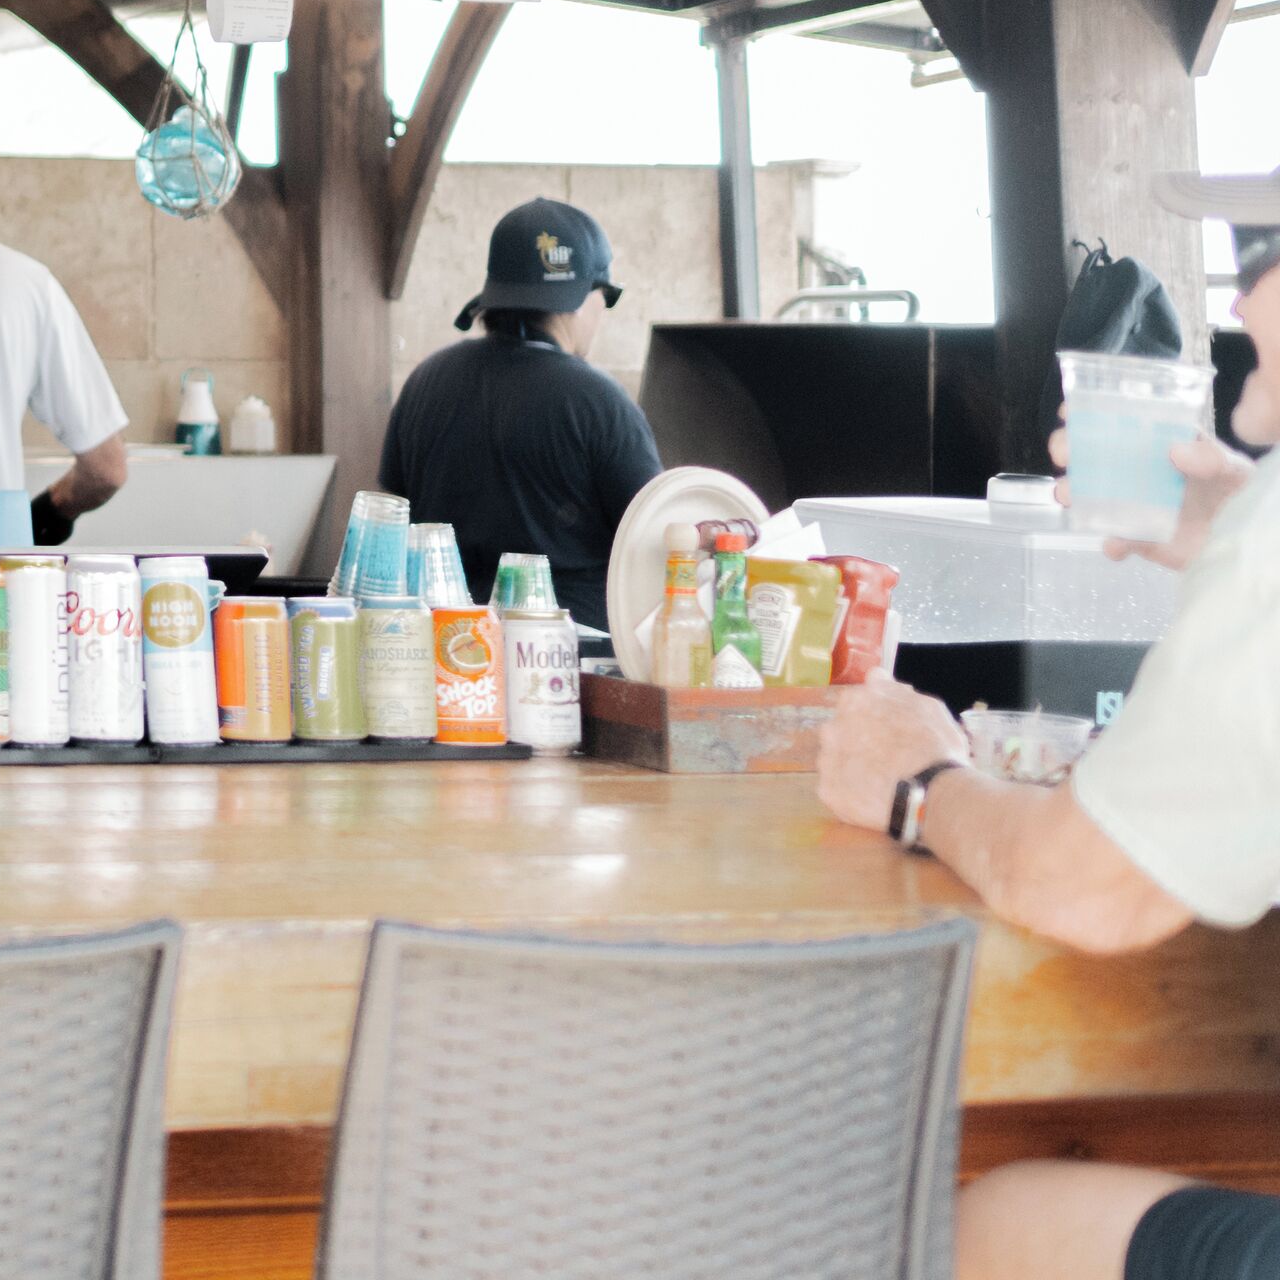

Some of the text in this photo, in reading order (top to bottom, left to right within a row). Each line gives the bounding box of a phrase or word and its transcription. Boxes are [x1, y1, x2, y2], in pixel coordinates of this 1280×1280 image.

[149, 614, 199, 627] NOON
[150, 600, 195, 614] HIGH
[254, 634, 272, 714] ATHLETIC
[319, 652, 330, 695] ORIGINAL
[436, 676, 496, 706] SHOCK
[460, 693, 497, 720] TOP
